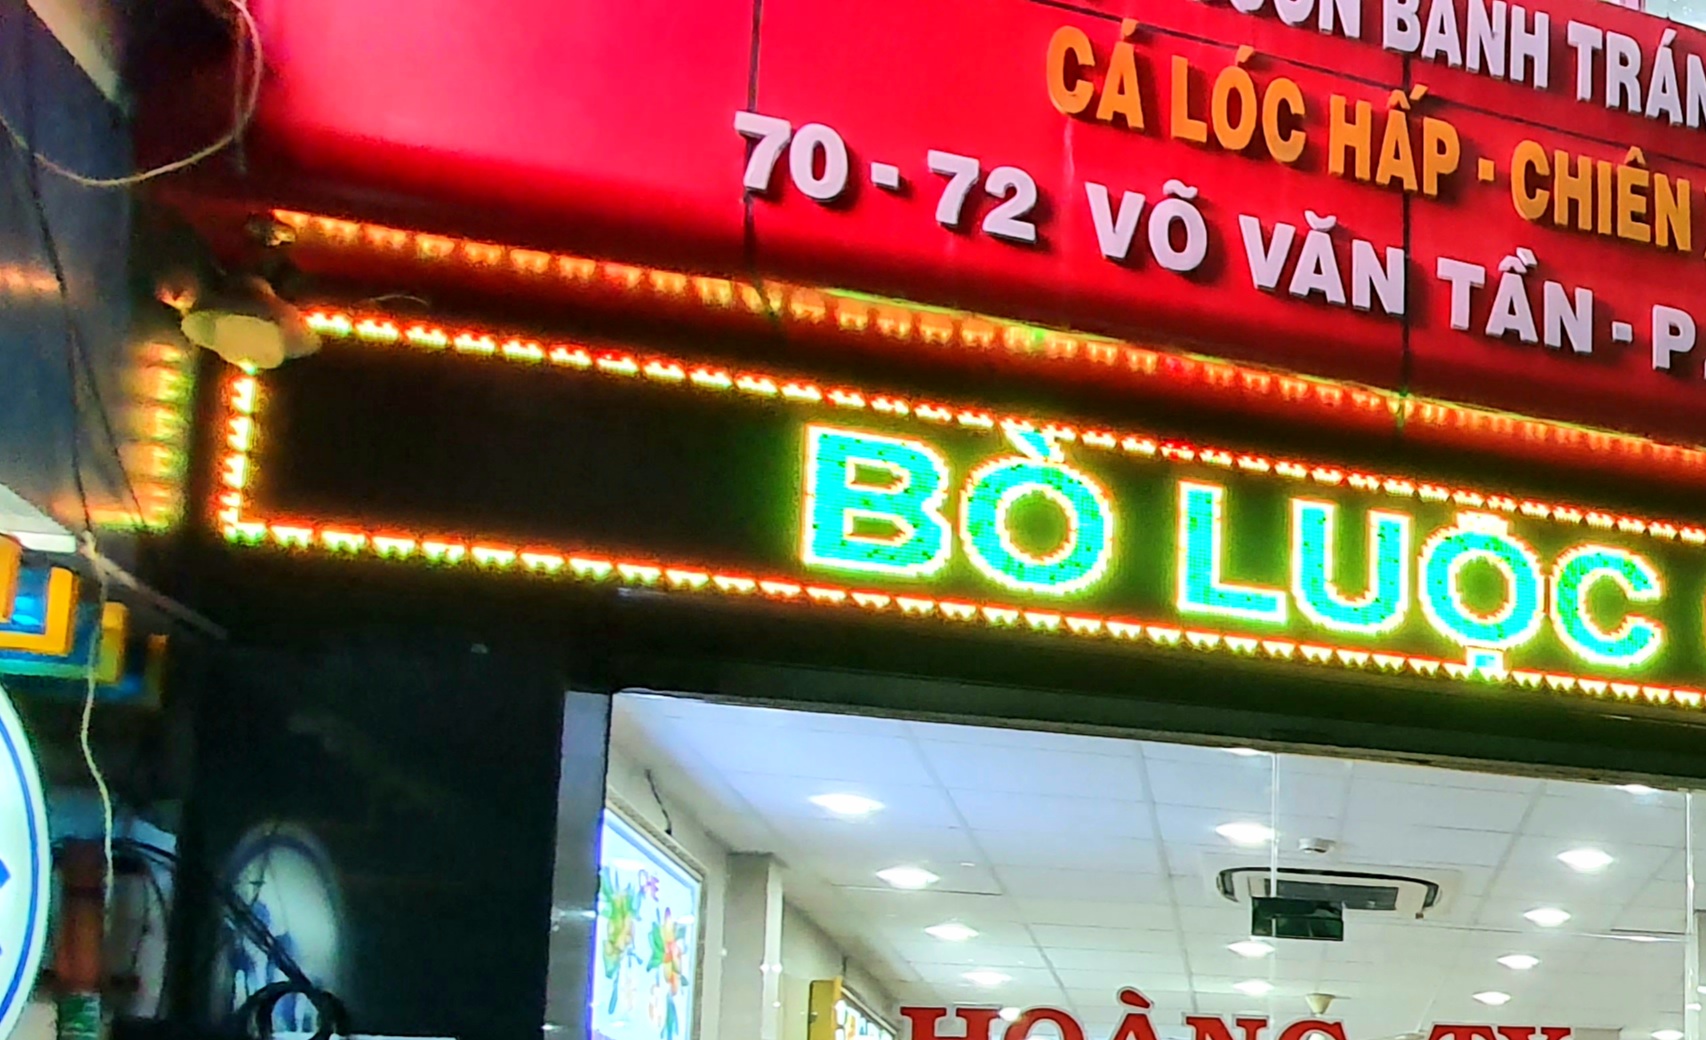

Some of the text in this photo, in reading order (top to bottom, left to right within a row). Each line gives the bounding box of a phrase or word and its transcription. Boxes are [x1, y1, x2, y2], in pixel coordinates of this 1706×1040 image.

[734, 111, 850, 202] 70
[927, 149, 1038, 244] 72
[1084, 178, 1207, 273] VÕ
[1239, 209, 1406, 316] VĂN
[1437, 247, 1594, 356] TẦN
[1046, 19, 1144, 130] CÁ
[1170, 46, 1306, 164] LÓC
[1328, 84, 1461, 197] HẤP
[1511, 140, 1691, 252] CHIÊN
[801, 419, 1116, 598] BÒ
[1176, 481, 1665, 680] LUỘC
